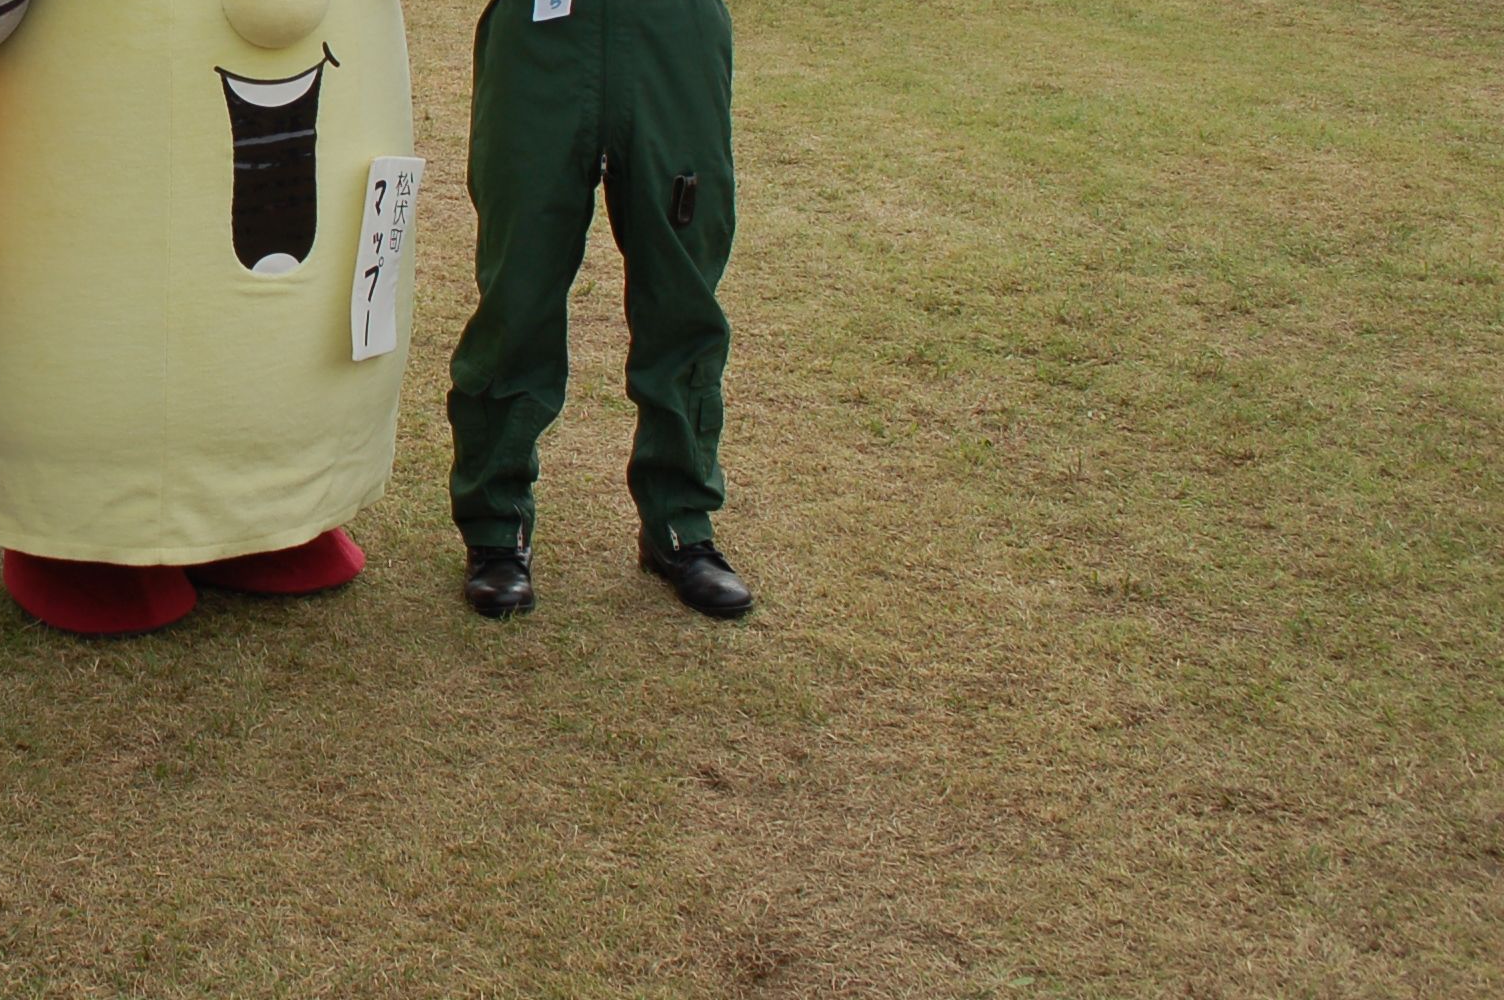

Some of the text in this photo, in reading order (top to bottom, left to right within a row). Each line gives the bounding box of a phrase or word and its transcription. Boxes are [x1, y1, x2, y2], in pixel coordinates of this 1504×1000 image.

[364, 180, 387, 347] マップー
[389, 170, 414, 253] 松伏町
